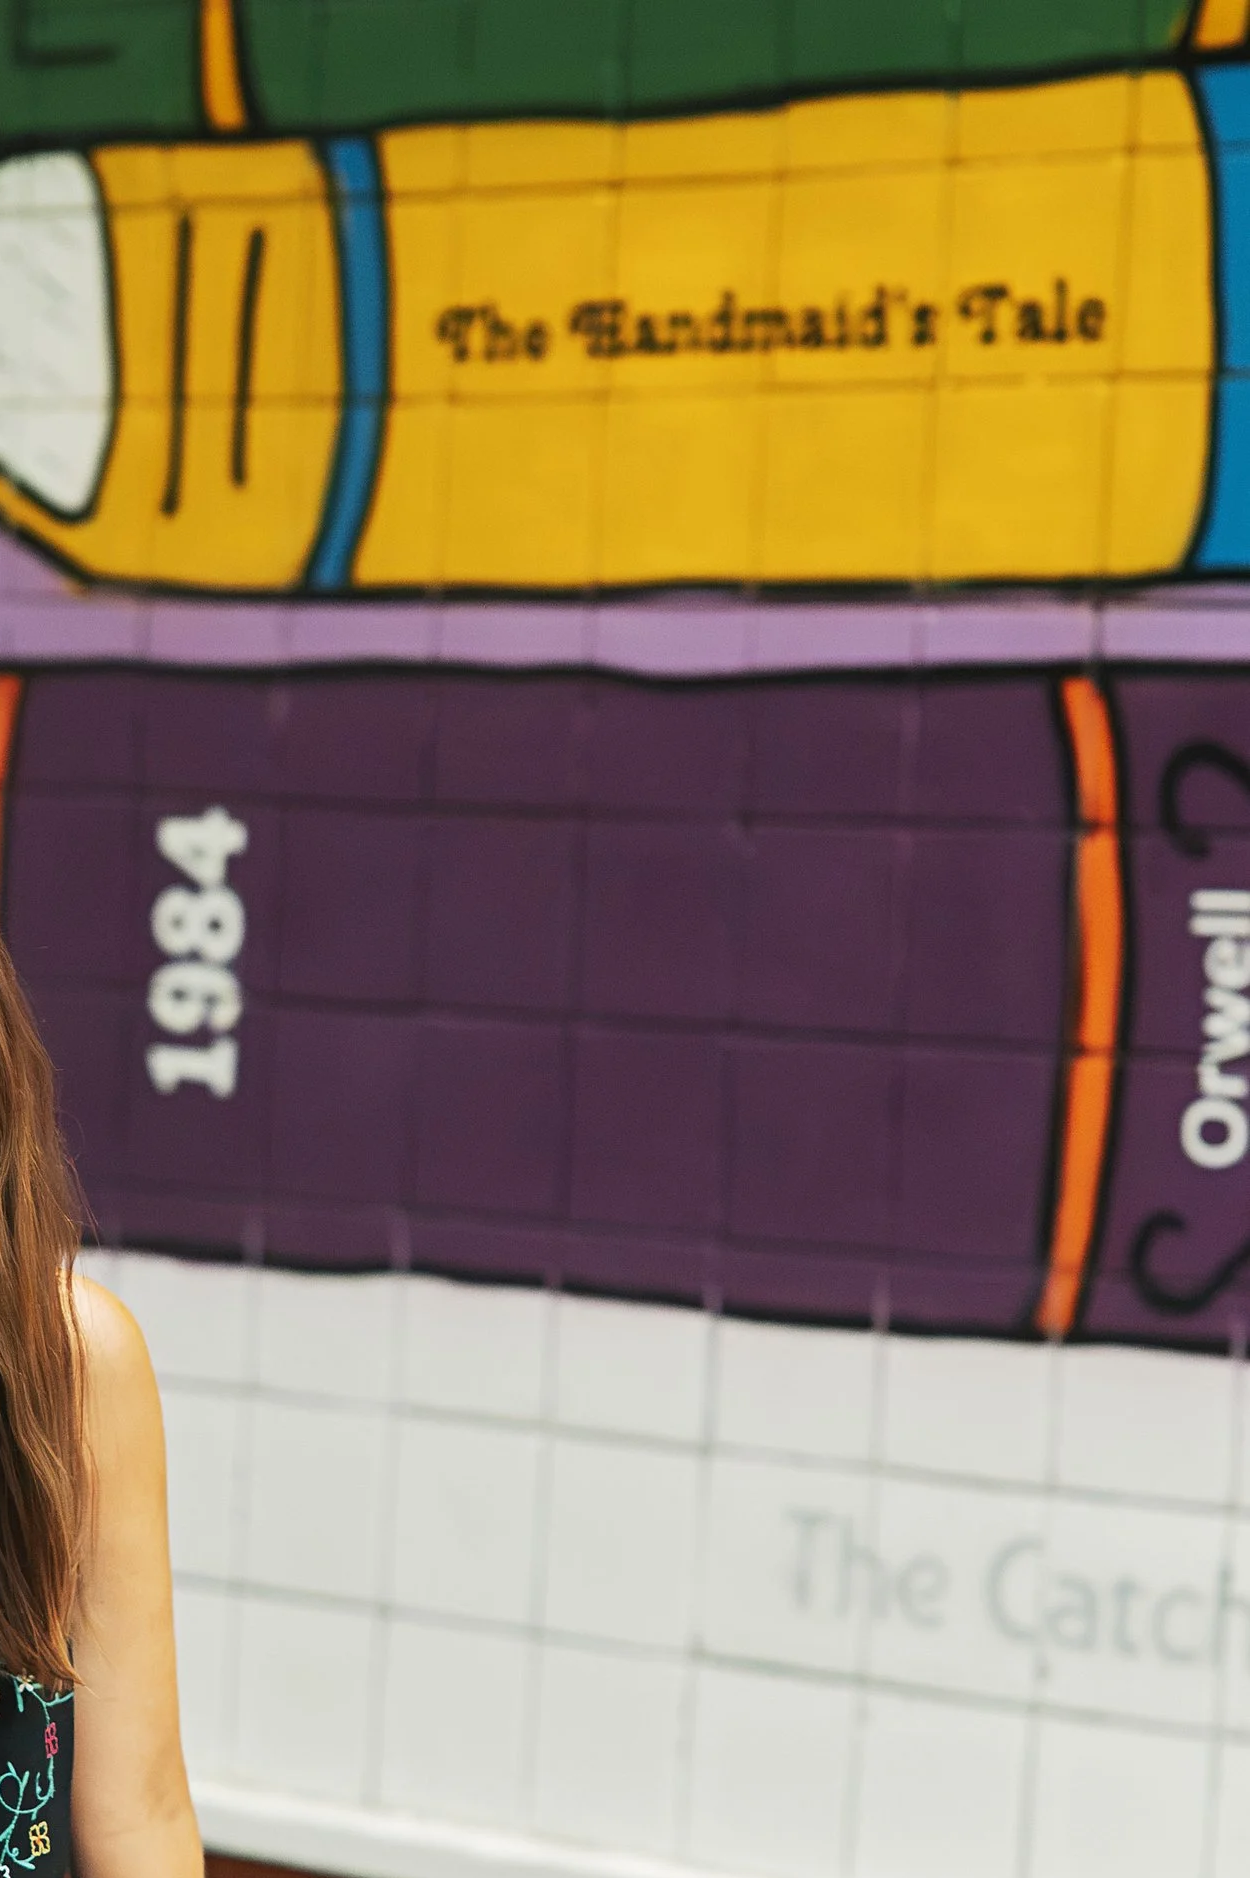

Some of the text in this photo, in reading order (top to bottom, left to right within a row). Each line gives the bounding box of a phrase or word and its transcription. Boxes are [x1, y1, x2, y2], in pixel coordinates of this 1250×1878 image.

[434, 277, 1107, 363] The Handmaid's Tale
[146, 805, 248, 1099] 1984
[1180, 888, 1250, 1169] Orwell
[783, 1506, 950, 1630] The
